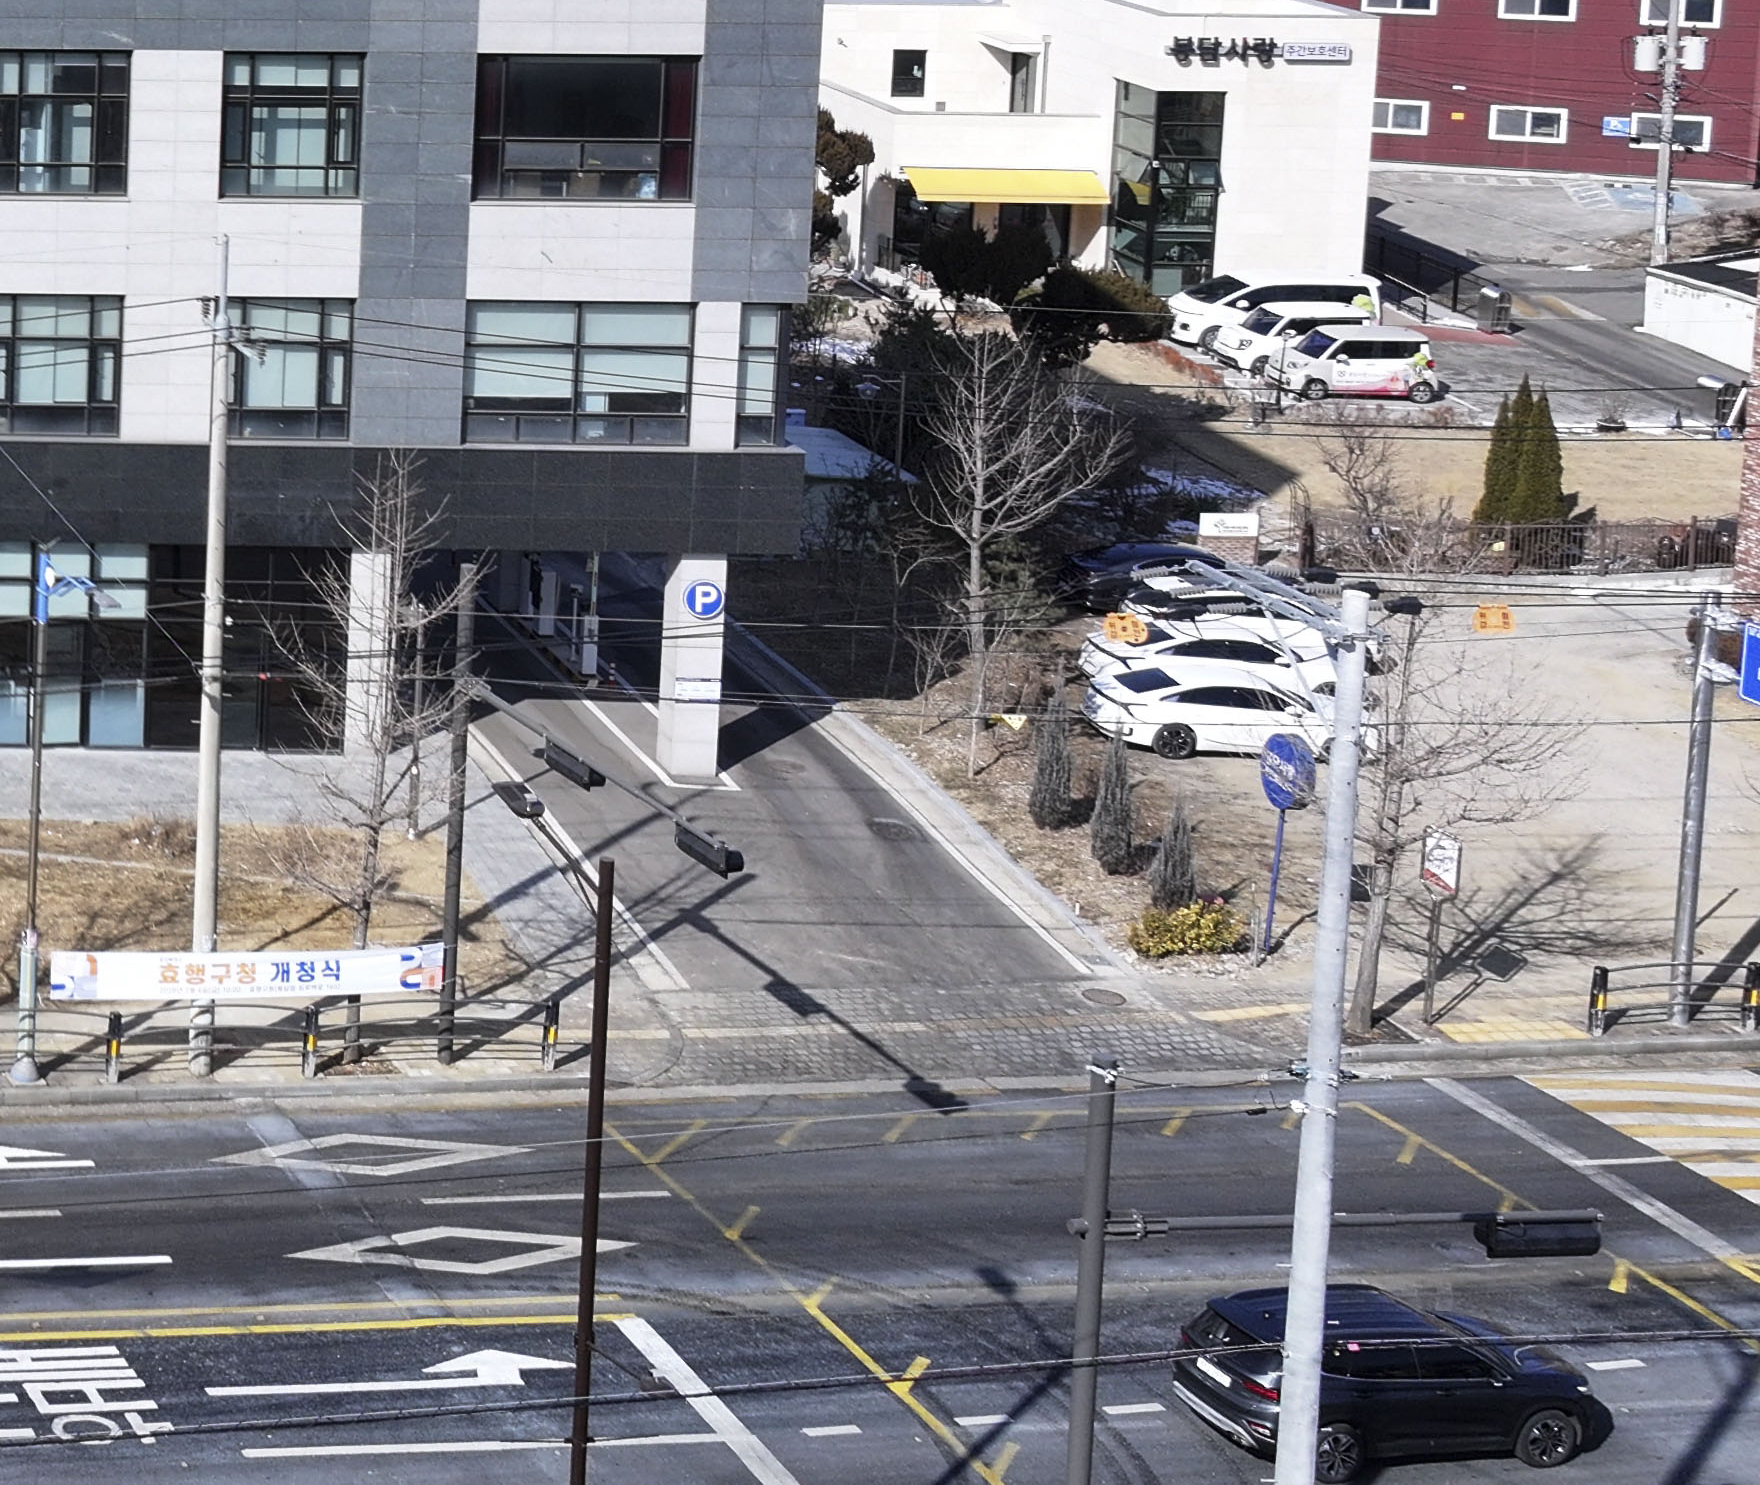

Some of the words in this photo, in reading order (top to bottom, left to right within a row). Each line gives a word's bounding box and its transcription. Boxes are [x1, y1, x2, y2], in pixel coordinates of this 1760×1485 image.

[1170, 36, 1279, 63] 봉담사랑
[1286, 44, 1348, 58] 주간보호센터
[158, 962, 257, 985] 효행구청
[270, 960, 342, 983] 개청식
